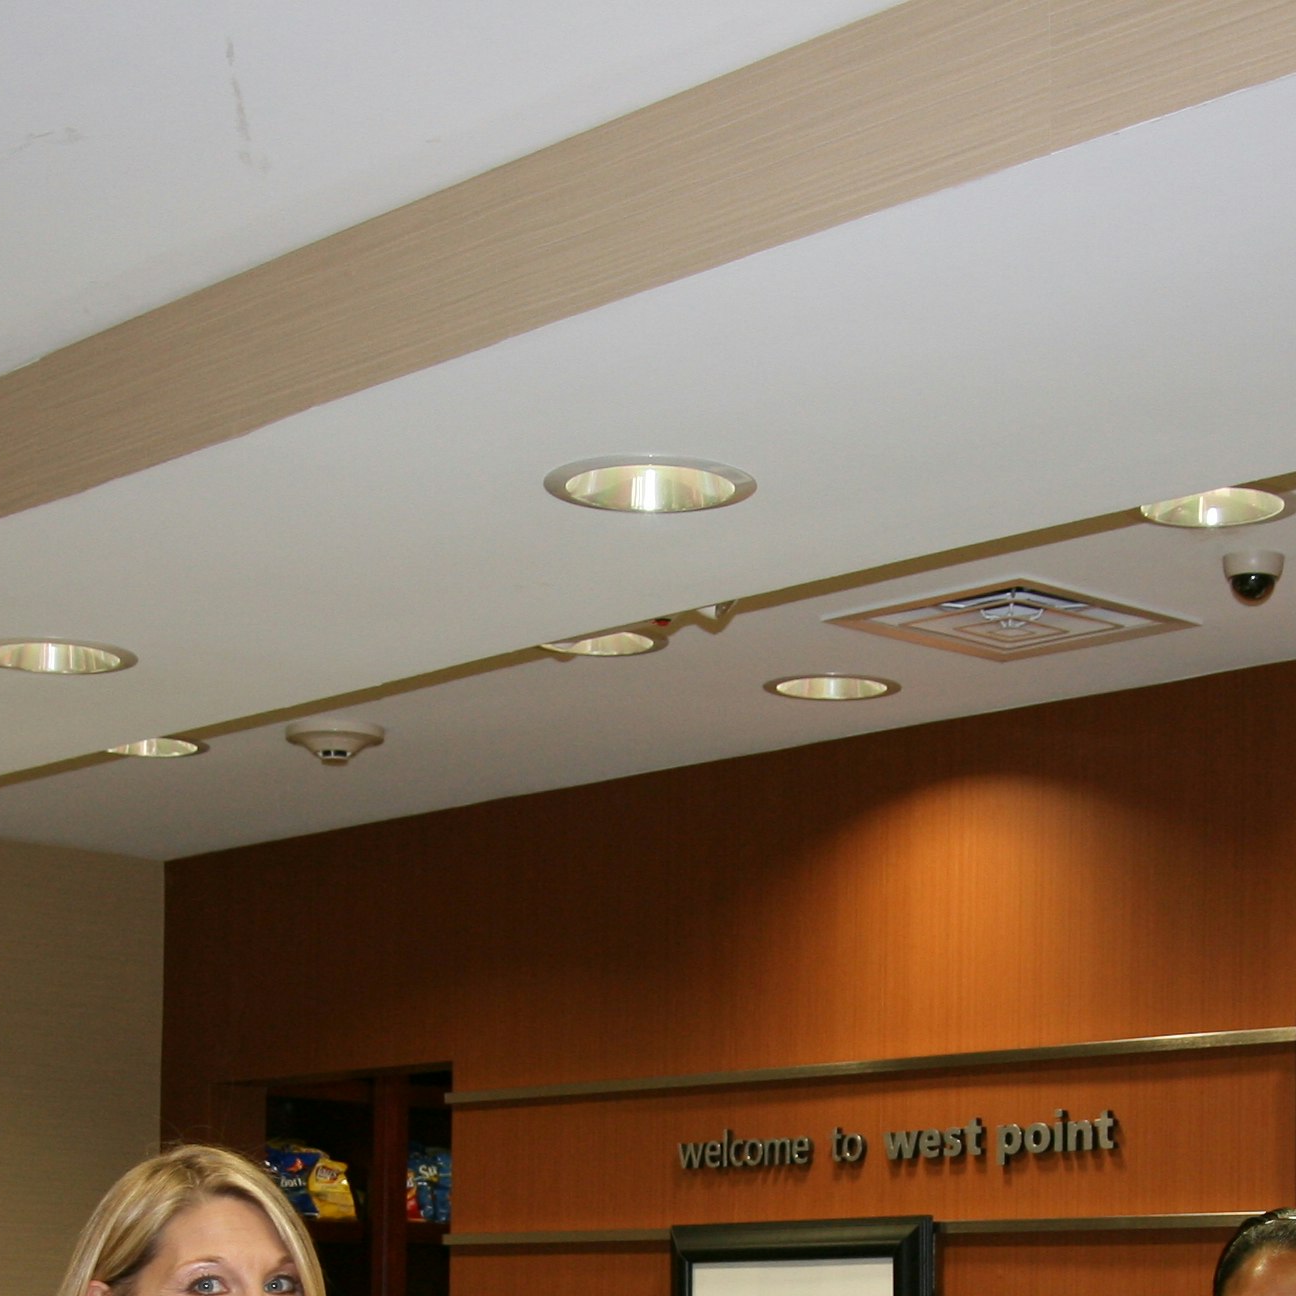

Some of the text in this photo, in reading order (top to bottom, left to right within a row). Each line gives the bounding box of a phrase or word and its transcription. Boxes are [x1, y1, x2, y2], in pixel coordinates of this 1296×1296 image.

[678, 1109, 1118, 1168] welcome to west point
